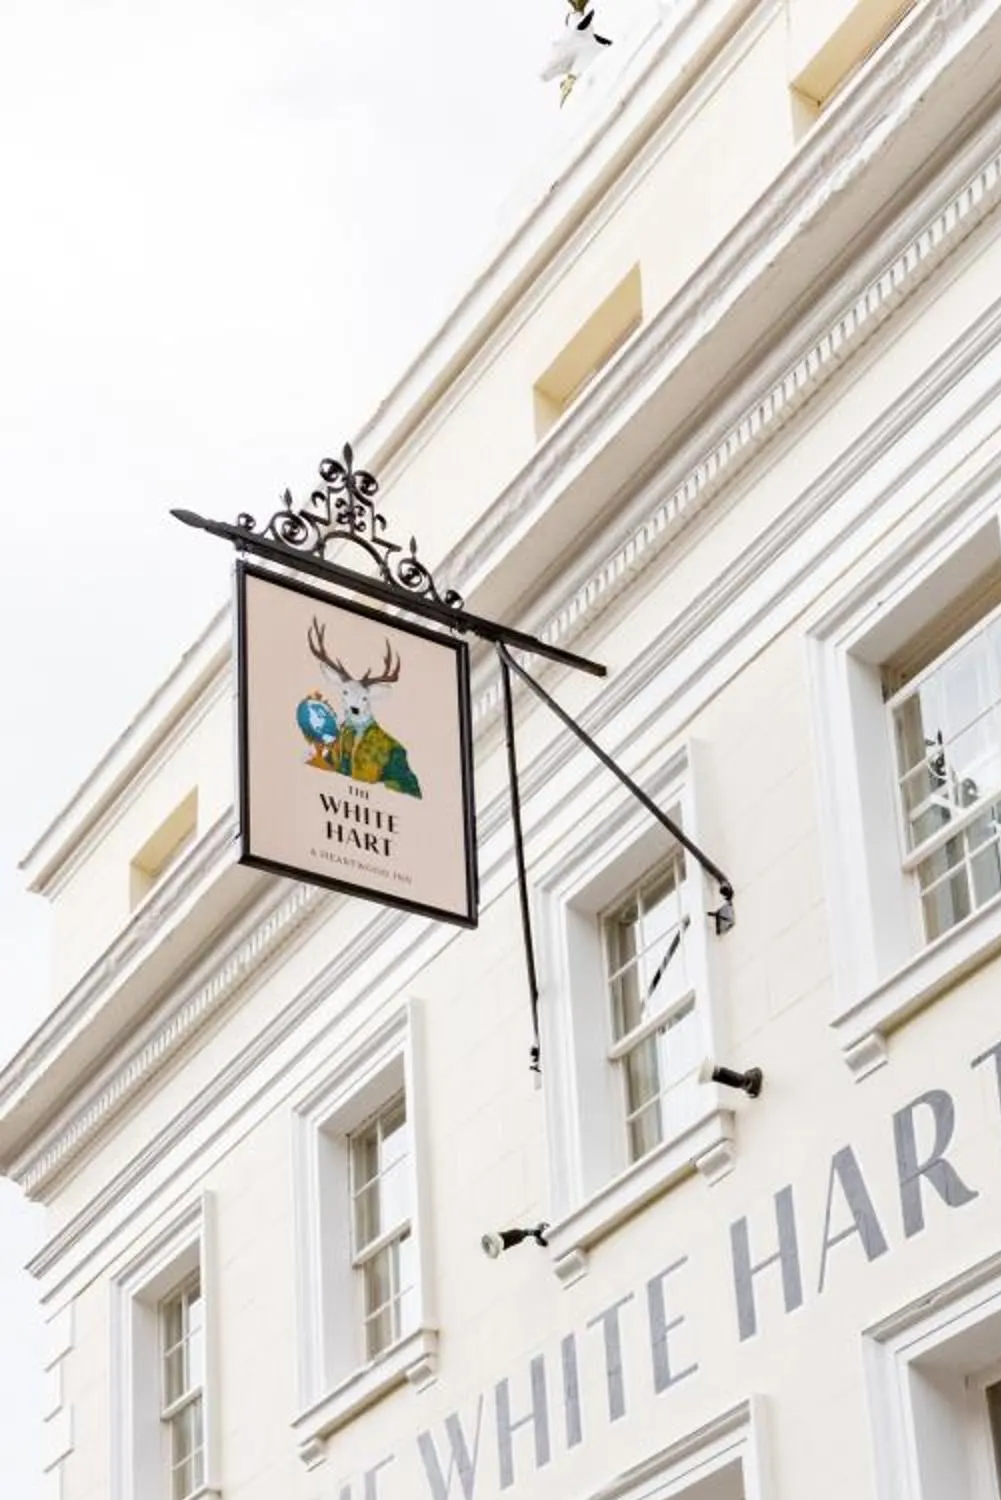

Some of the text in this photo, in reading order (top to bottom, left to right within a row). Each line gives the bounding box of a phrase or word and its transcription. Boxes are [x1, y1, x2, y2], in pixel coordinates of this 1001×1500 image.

[348, 785, 369, 800] THE
[319, 793, 401, 834] WHITE
[326, 821, 392, 856] HART
